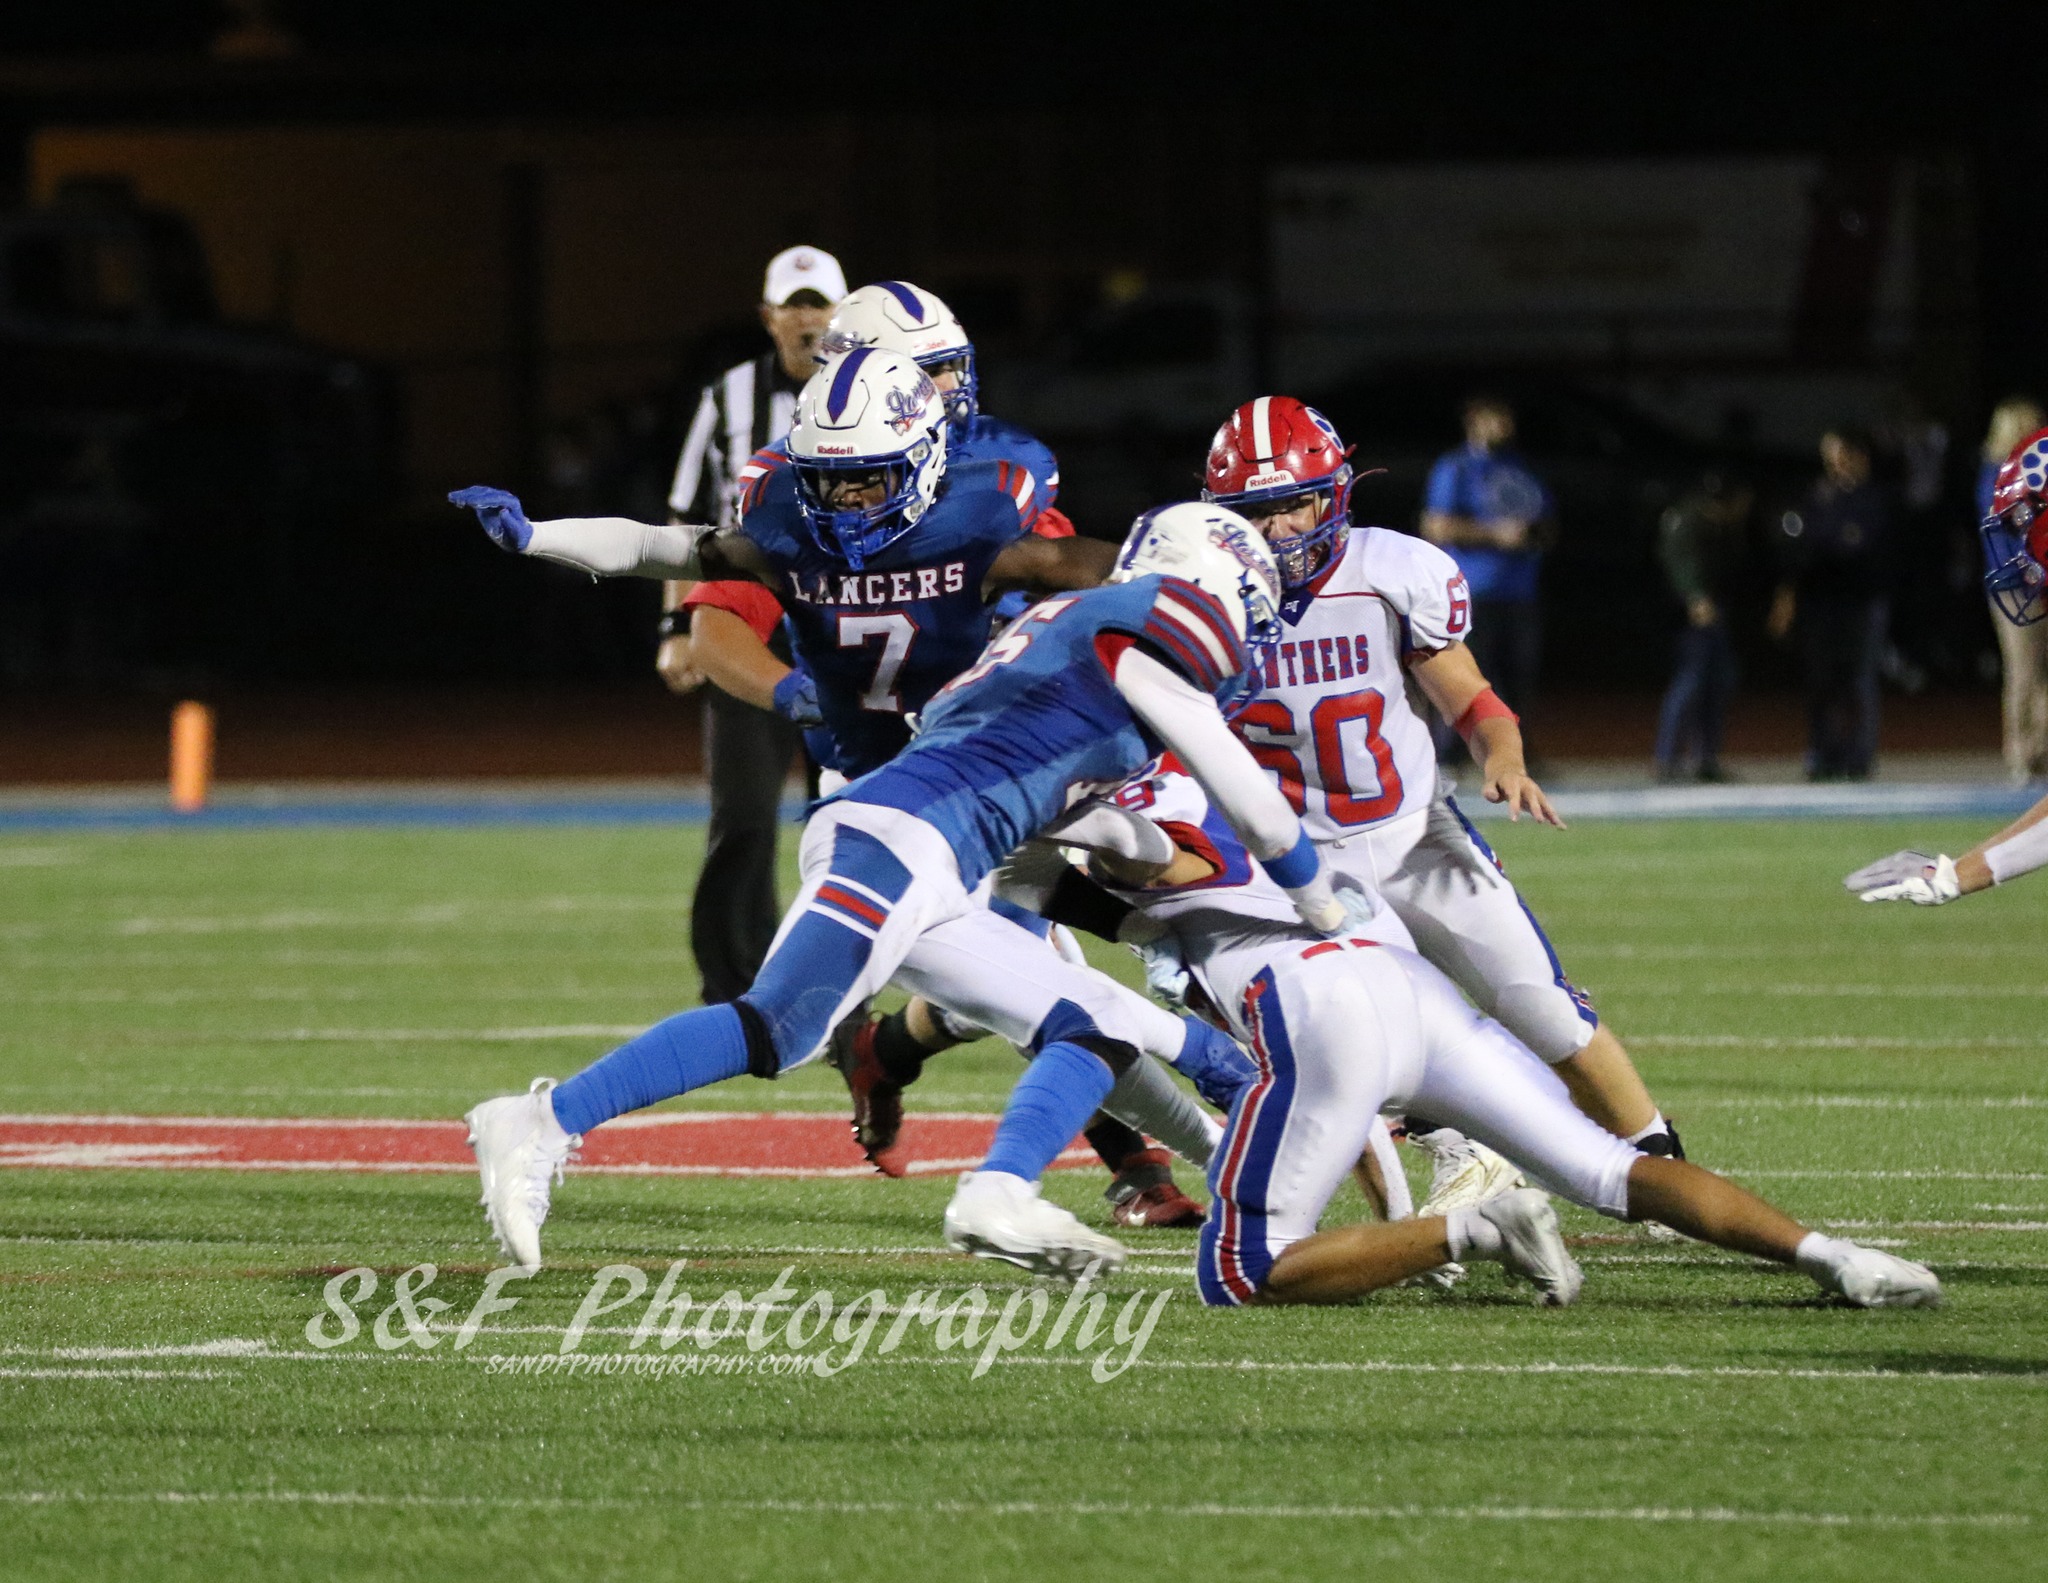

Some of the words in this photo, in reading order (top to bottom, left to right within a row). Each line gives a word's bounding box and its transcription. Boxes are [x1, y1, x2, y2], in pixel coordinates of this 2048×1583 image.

[817, 445, 853, 455] Riddell
[1250, 474, 1287, 487] Riddell
[789, 562, 964, 604] LANCERS
[836, 610, 920, 712] 7
[1250, 634, 1369, 688] NTHERS
[1226, 687, 1404, 828] 60
